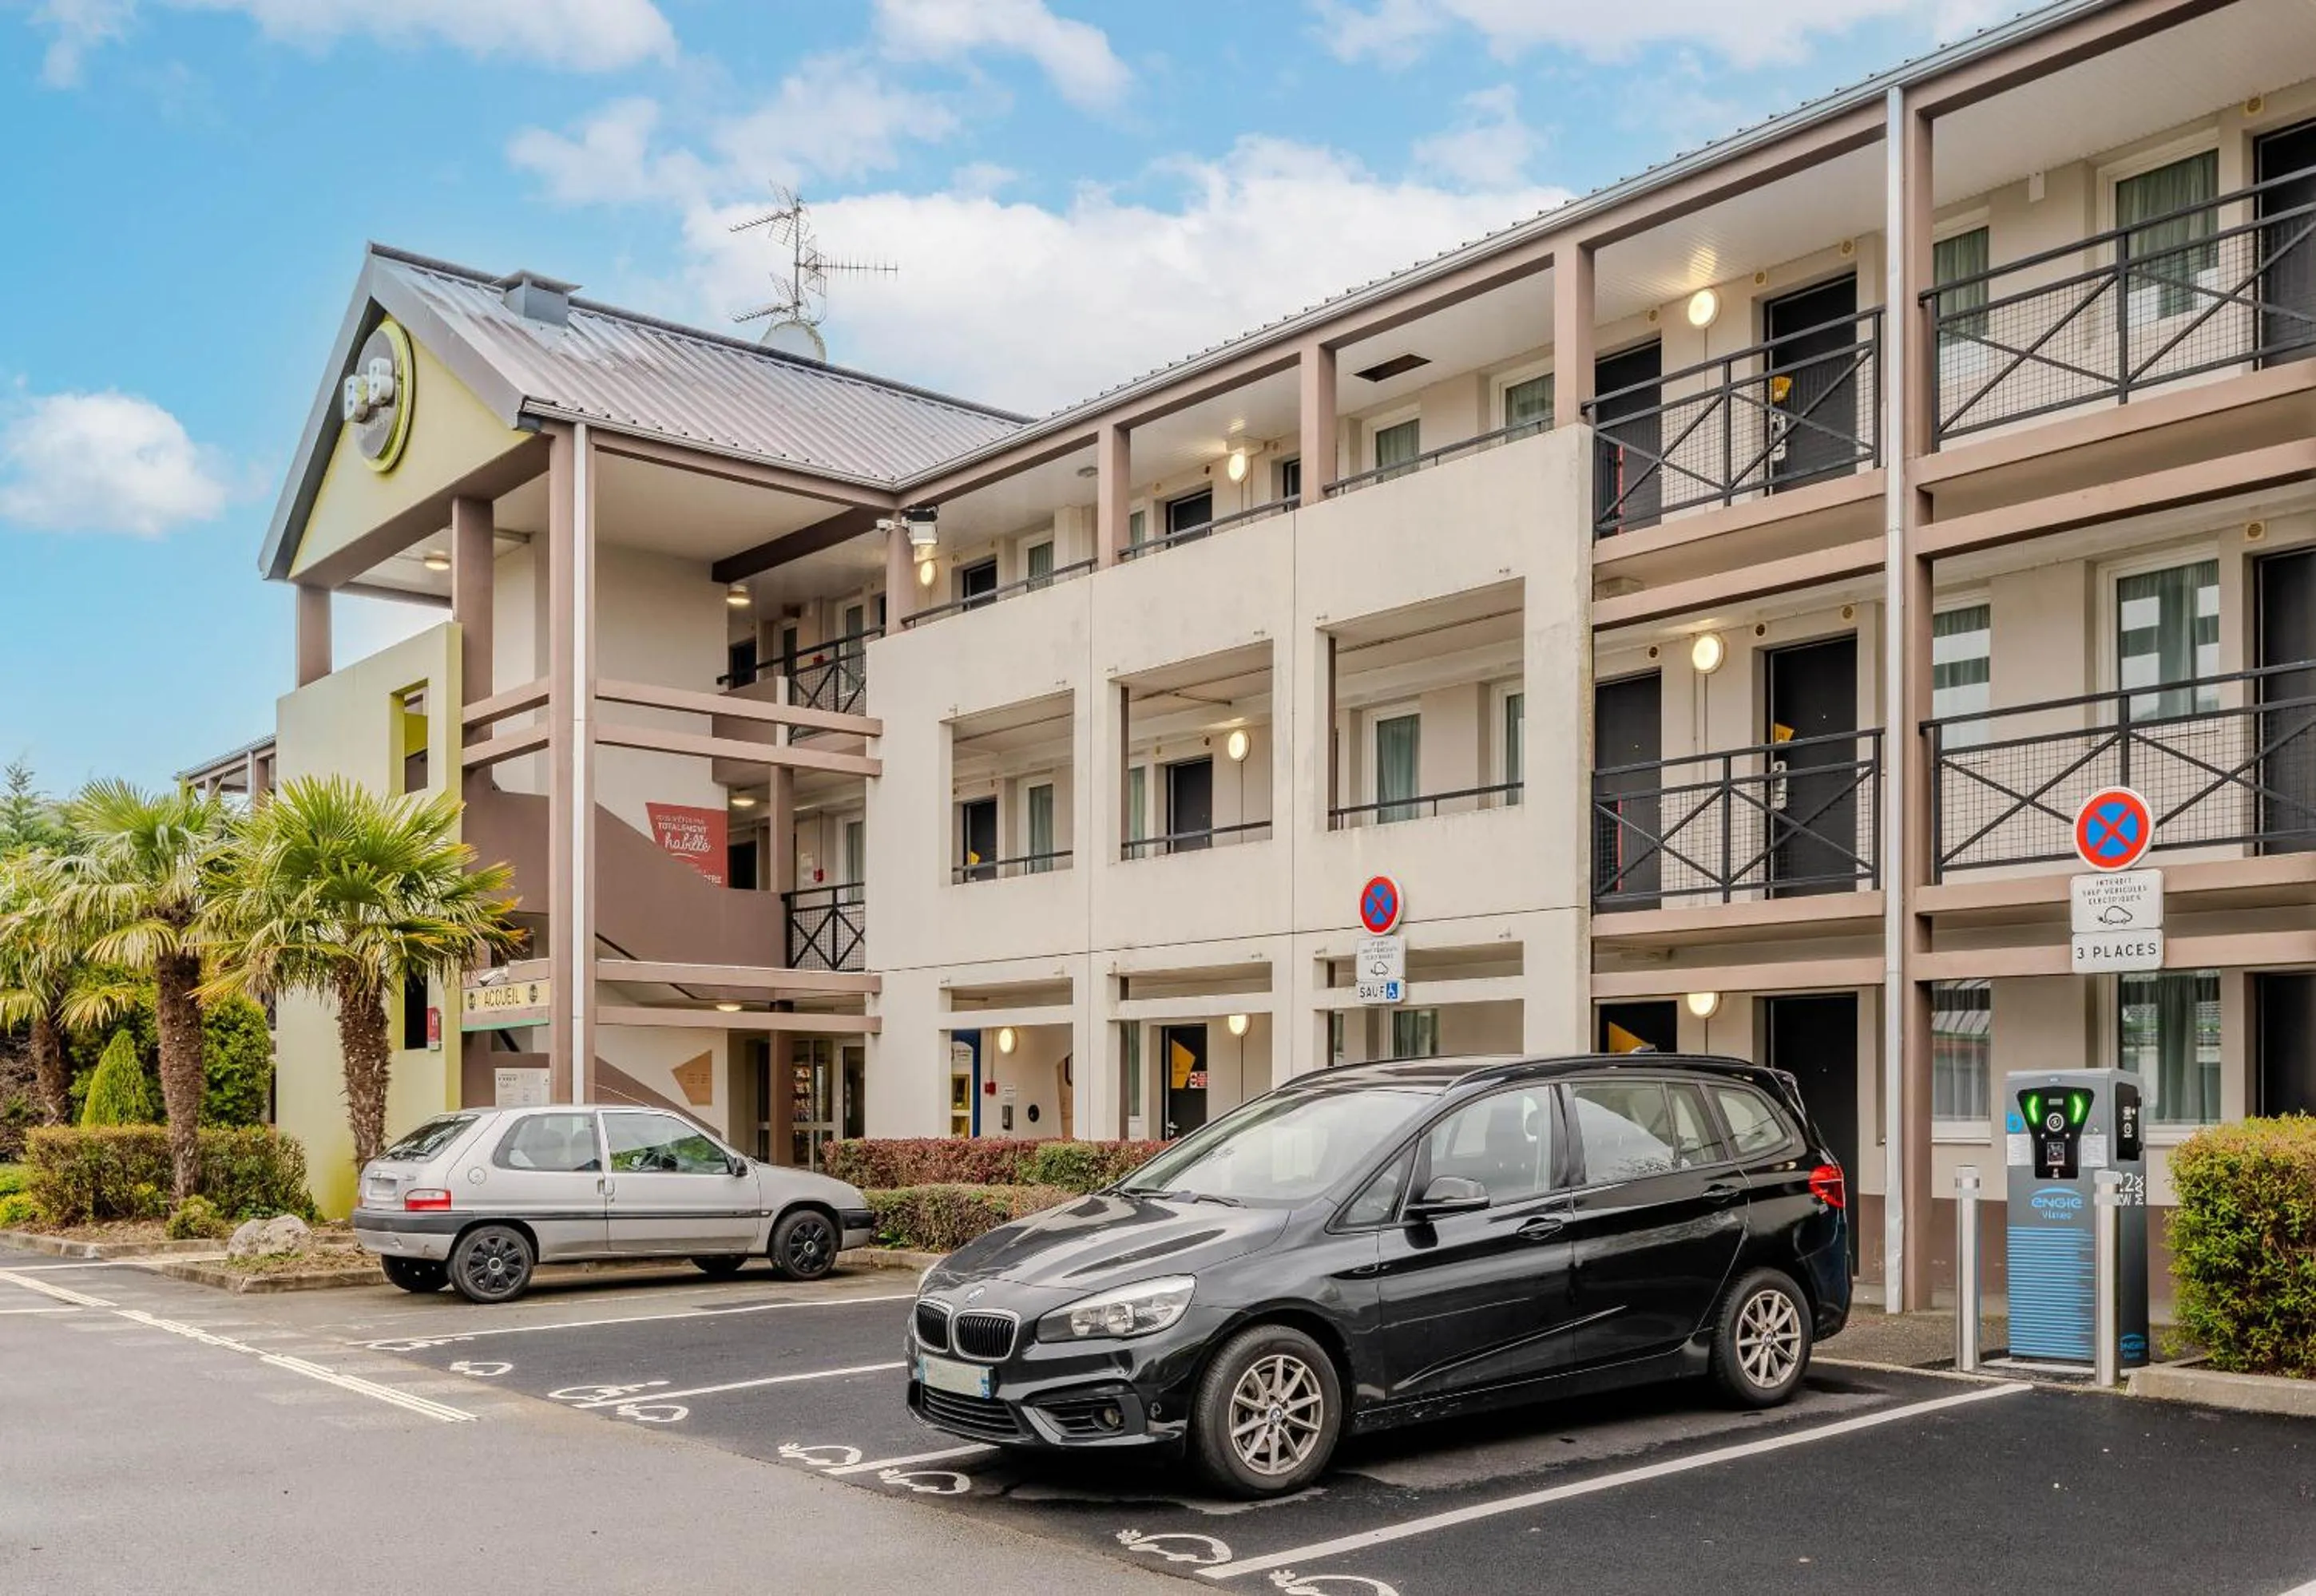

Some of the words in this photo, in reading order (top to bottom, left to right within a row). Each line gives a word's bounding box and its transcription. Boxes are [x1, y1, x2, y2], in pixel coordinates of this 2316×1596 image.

[657, 822, 708, 834] TOTALEMENT
[2076, 947, 2084, 960] 3
[2093, 942, 2156, 958] PLACES
[484, 987, 520, 1007] ACCUEIL
[1360, 985, 1384, 998] SAUF
